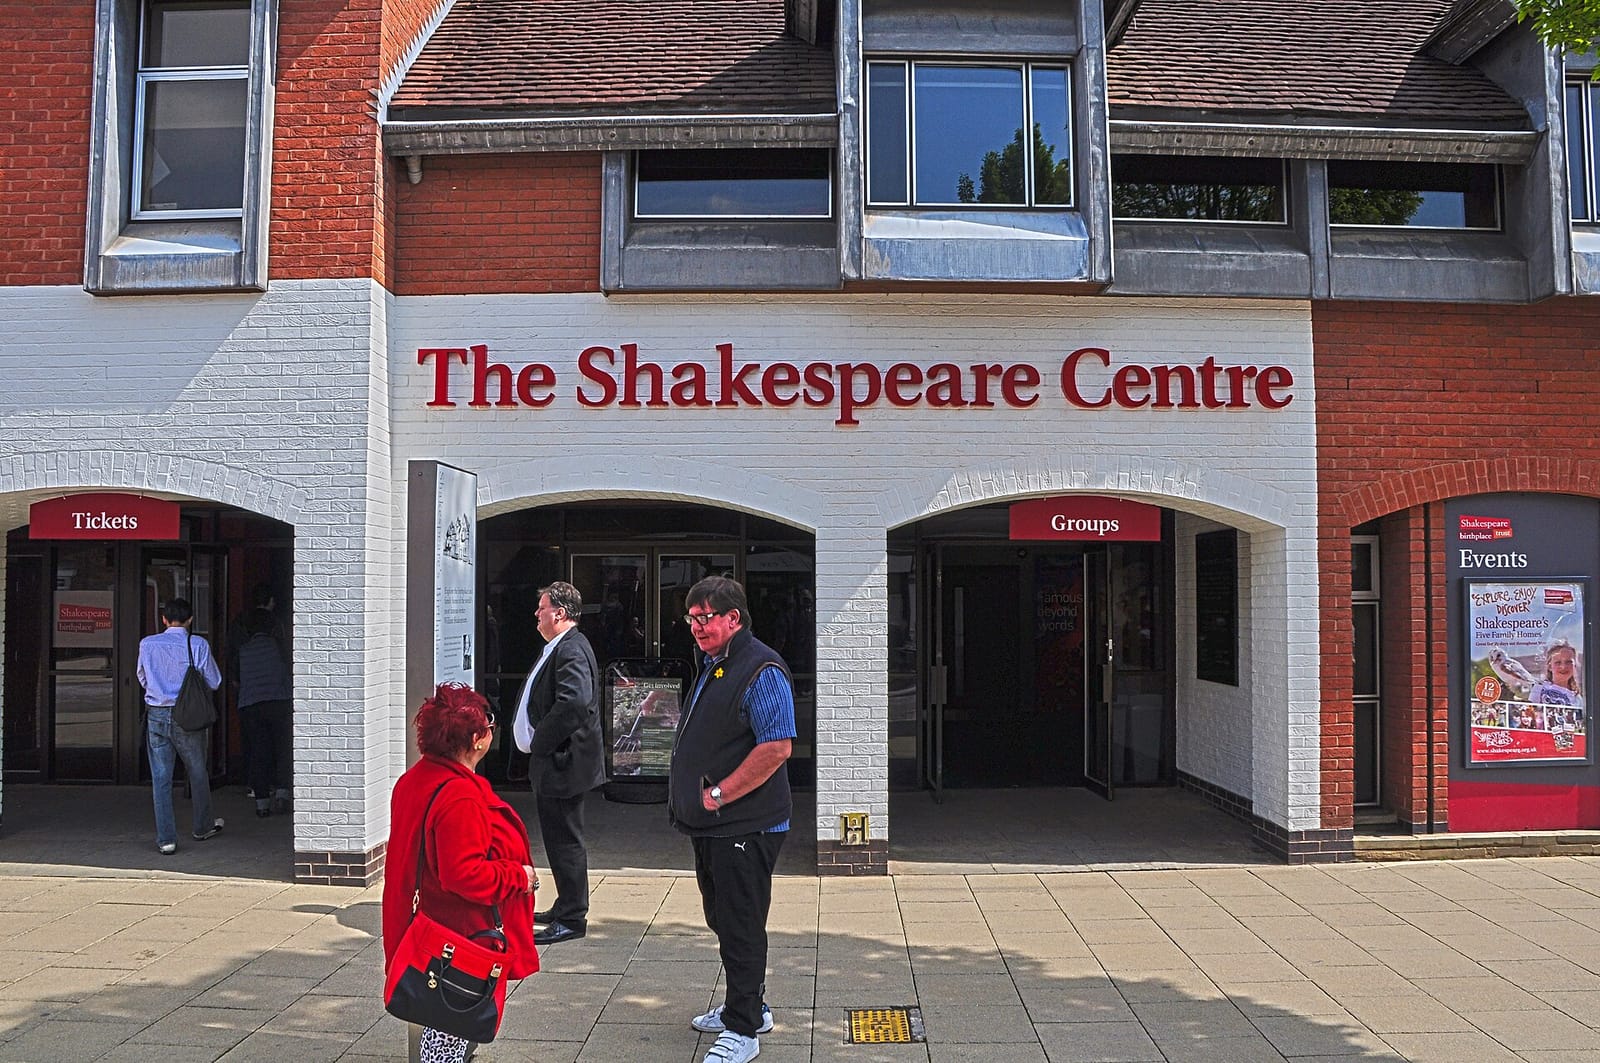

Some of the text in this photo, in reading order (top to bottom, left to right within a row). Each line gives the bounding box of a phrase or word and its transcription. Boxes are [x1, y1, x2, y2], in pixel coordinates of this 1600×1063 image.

[417, 343, 1294, 426] The Shakespeare Centre
[71, 511, 138, 530] Tickets
[1051, 514, 1119, 536] Groups
[1460, 519, 1509, 529] Shakespeare
[1459, 532, 1492, 541] birthplace
[1459, 549, 1528, 568] Events
[60, 607, 110, 619] Shakespeare
[1037, 605, 1077, 620] beyond
[59, 623, 92, 632] birthplace
[1038, 619, 1074, 630] words
[1475, 616, 1549, 631] Shakespeare's
[1475, 630, 1543, 640] Five Family Homes
[1484, 681, 1495, 691] 12
